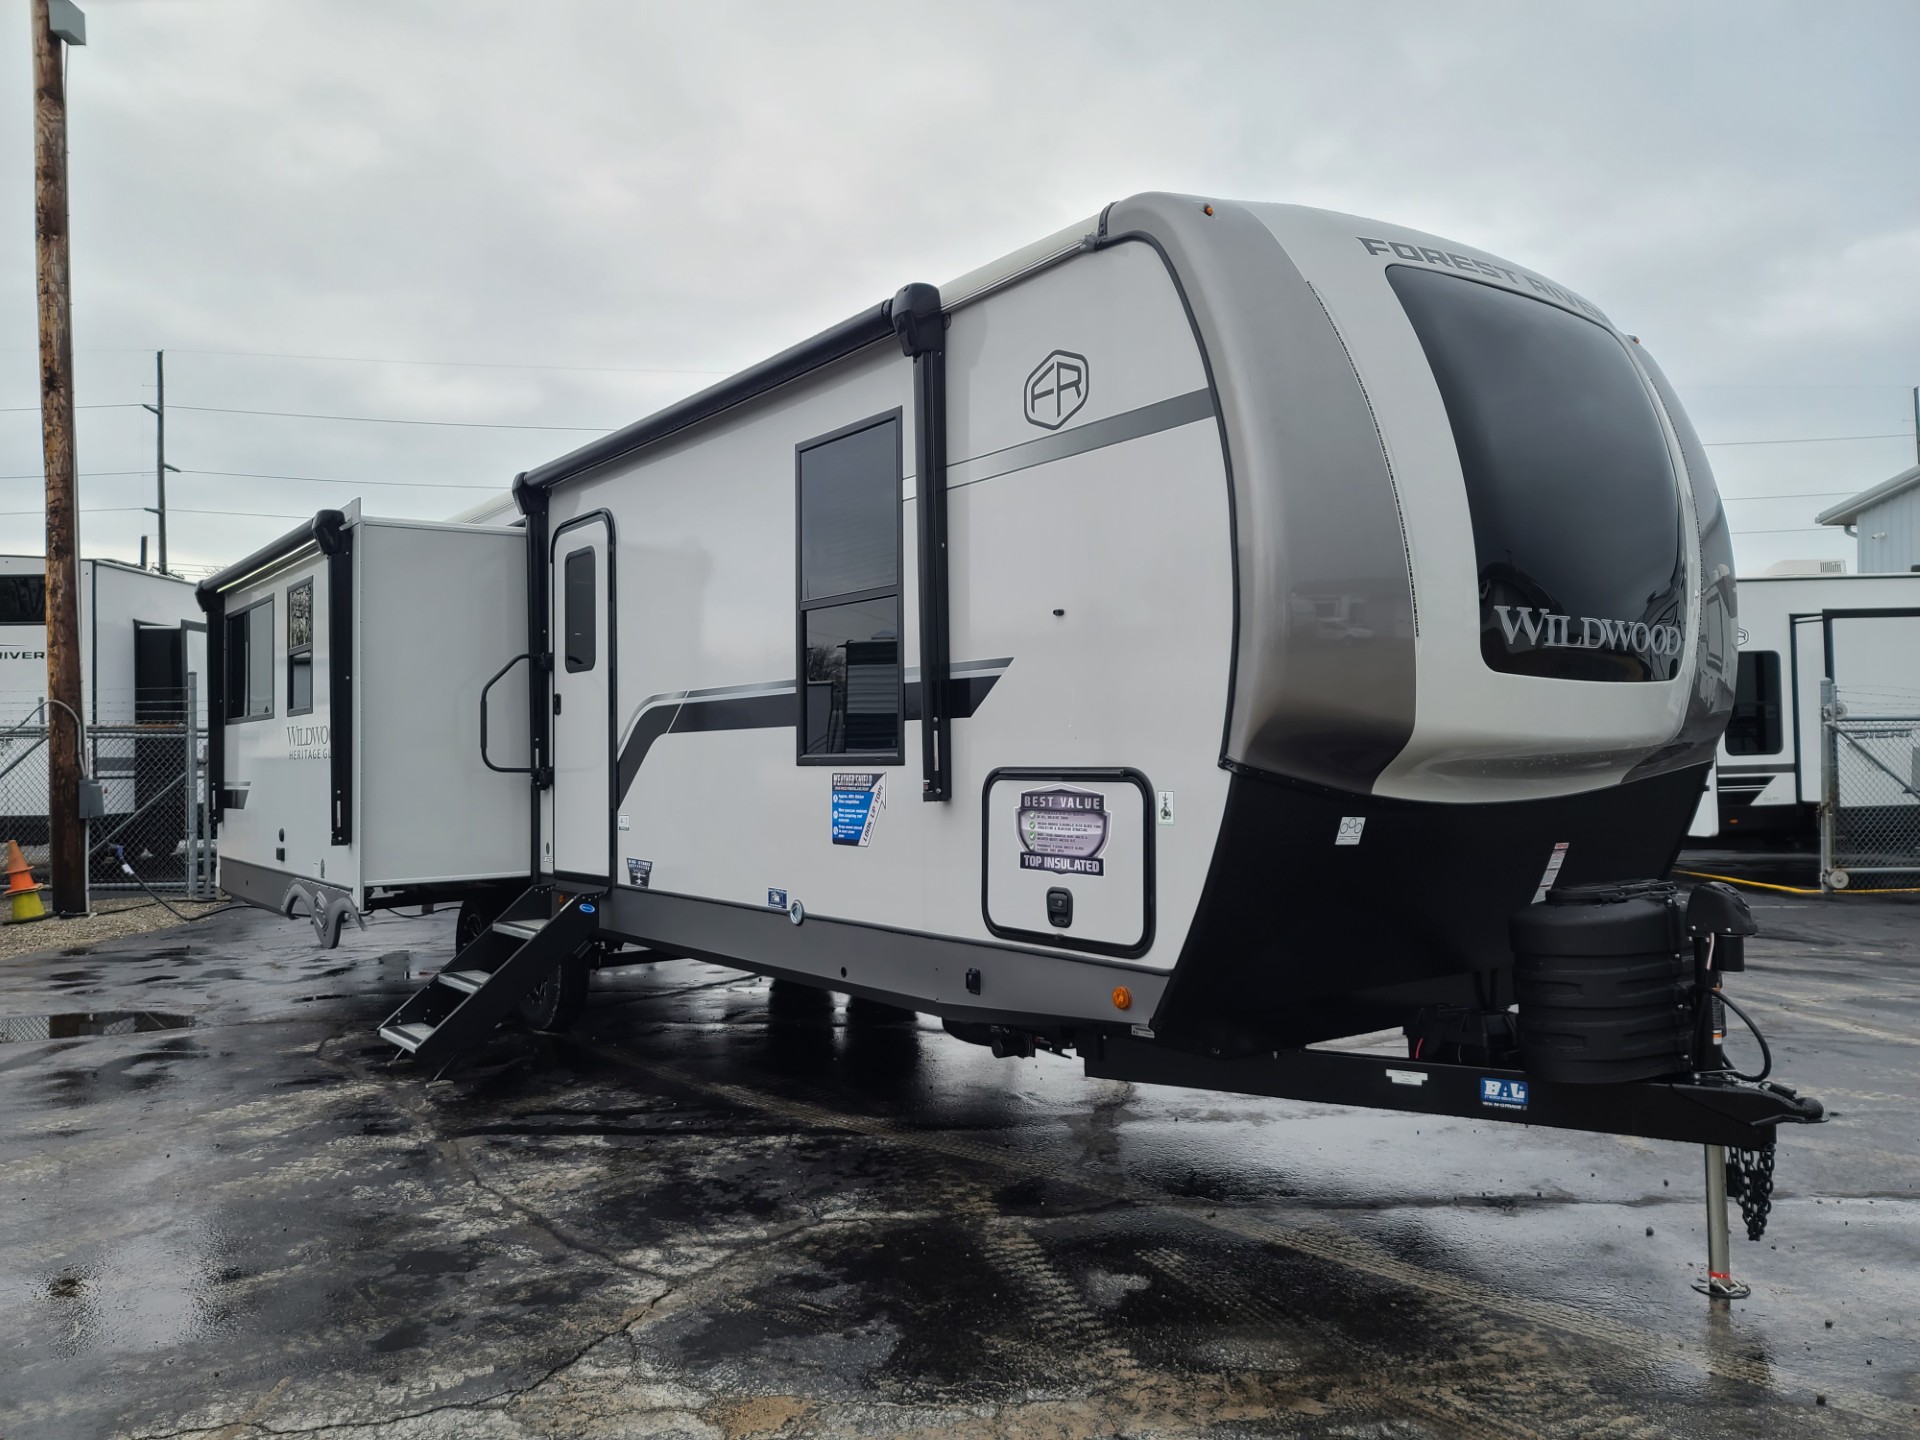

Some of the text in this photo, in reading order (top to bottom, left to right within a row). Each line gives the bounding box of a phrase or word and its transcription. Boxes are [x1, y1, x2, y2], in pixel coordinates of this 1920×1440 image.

[1355, 236, 1519, 285] FOREST
[1493, 605, 1682, 656] WILDWOOD
[0, 651, 45, 660] IVER
[287, 725, 331, 747] WILDWO
[289, 749, 322, 760] HERITAGE
[1024, 795, 1101, 810] BEST VALUE
[863, 821, 873, 842] LOOK
[1024, 854, 1100, 873] TOP INSULATED
